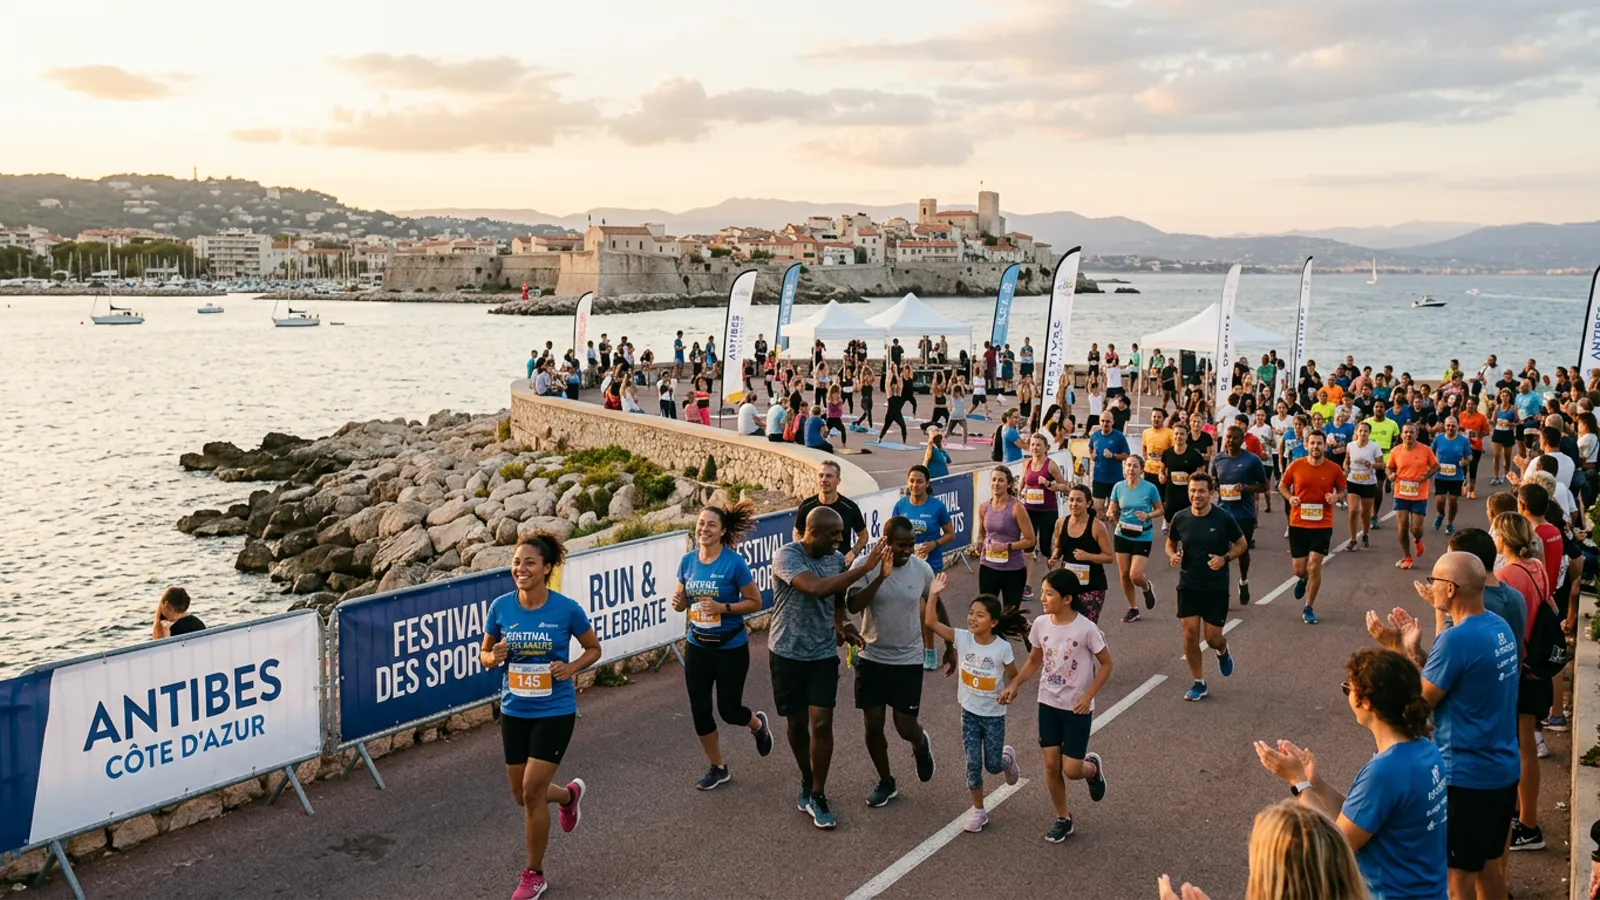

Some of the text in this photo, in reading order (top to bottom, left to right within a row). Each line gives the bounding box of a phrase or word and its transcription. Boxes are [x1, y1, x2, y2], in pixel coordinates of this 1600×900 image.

[736, 533, 784, 566] ESTIVA
[589, 561, 657, 613] RUN &
[588, 598, 667, 642] ELEBRATE
[376, 641, 504, 703] DES SPOR
[517, 674, 541, 688] 145
[83, 658, 282, 752] ANTIBES
[105, 714, 265, 779] CÔTE D'AZUR
